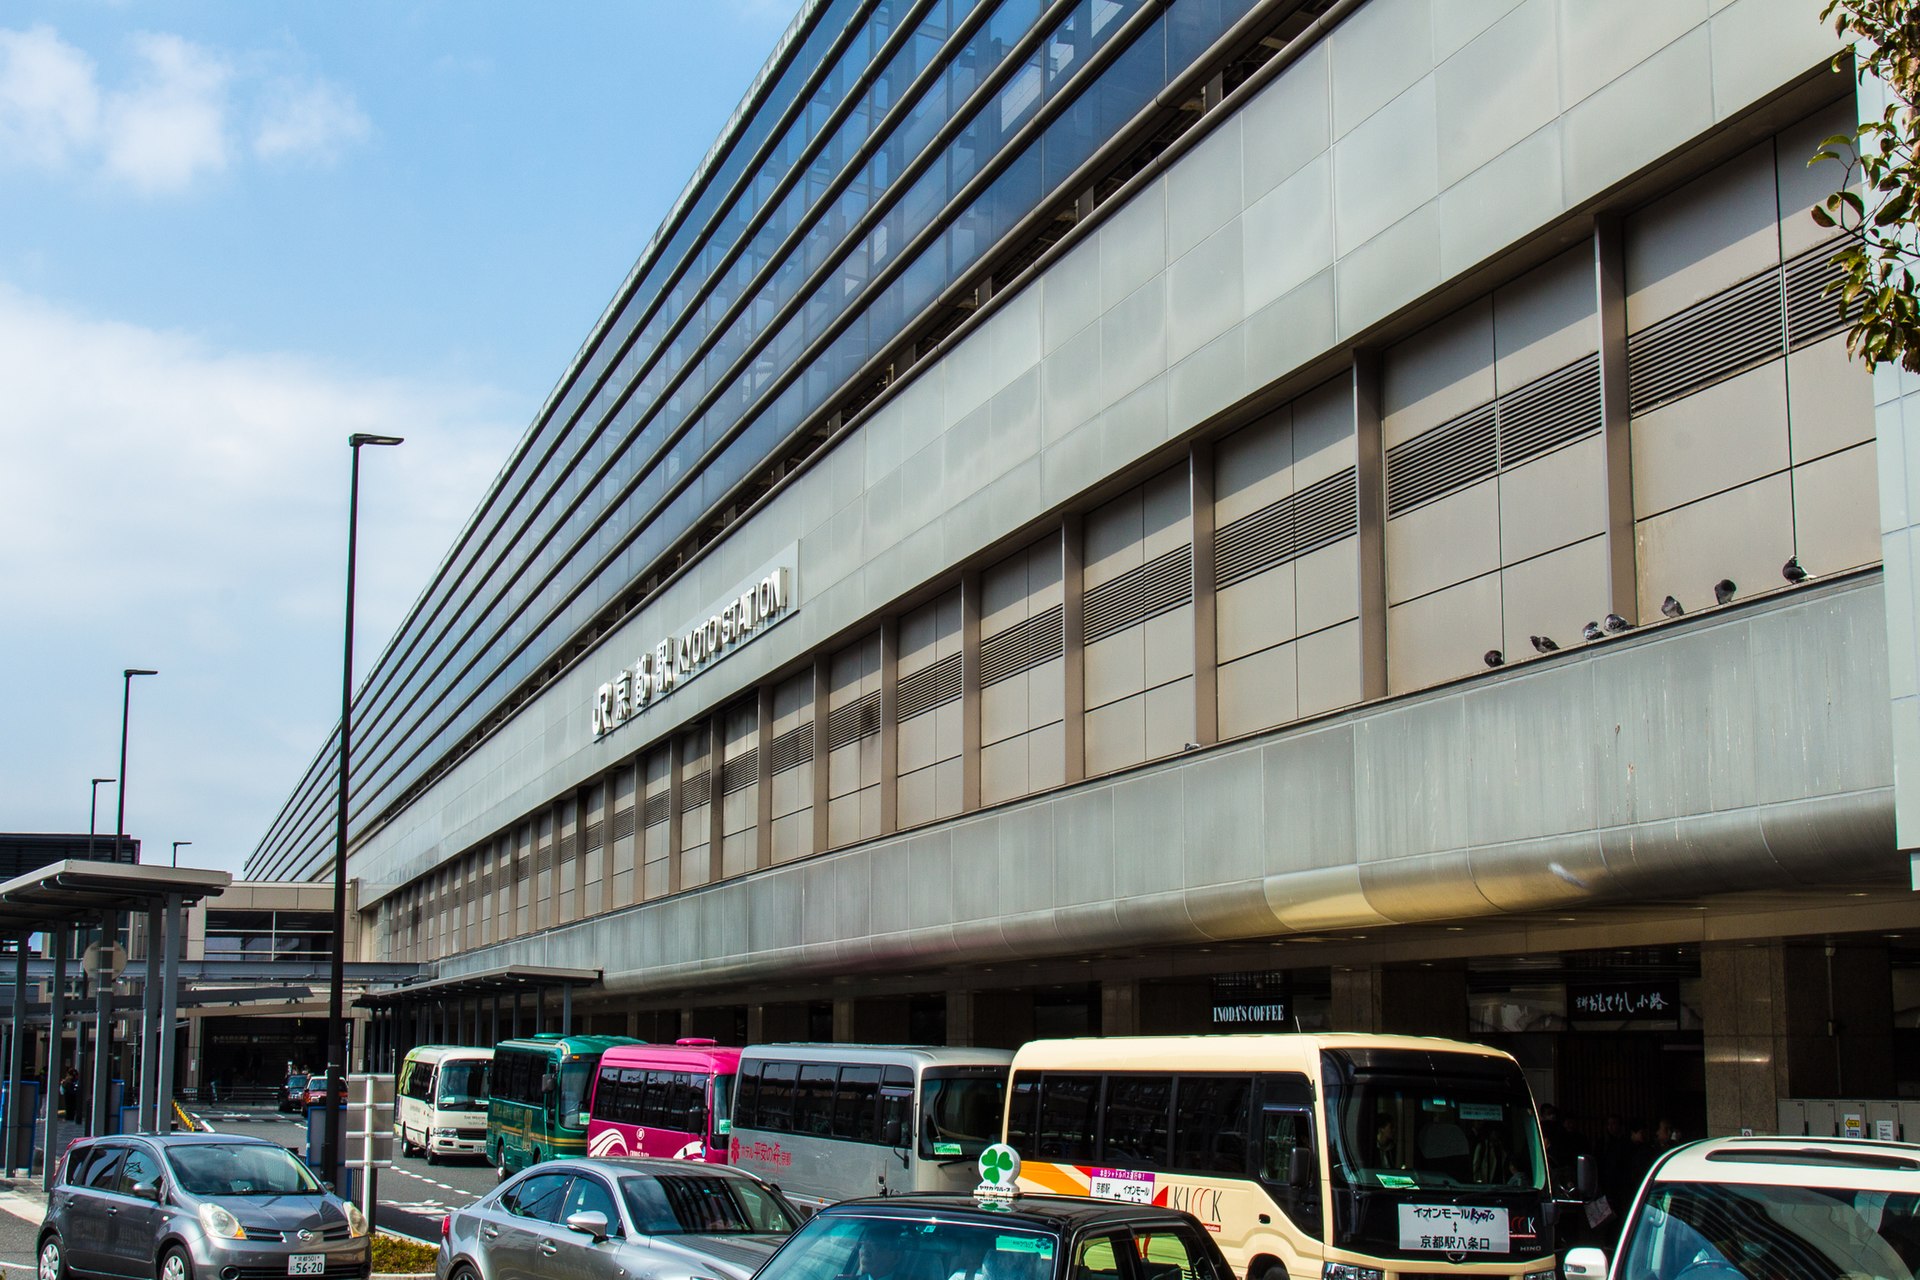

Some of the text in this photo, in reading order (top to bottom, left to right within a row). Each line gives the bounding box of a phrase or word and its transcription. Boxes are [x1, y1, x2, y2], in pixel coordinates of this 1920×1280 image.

[677, 615, 723, 674] KYOTO
[721, 567, 788, 645] STATION
[1213, 1004, 1284, 1022] INODA'S COFFEE
[1123, 1185, 1150, 1197] イオンモール
[1420, 1235, 1490, 1250] 京都駅八条口
